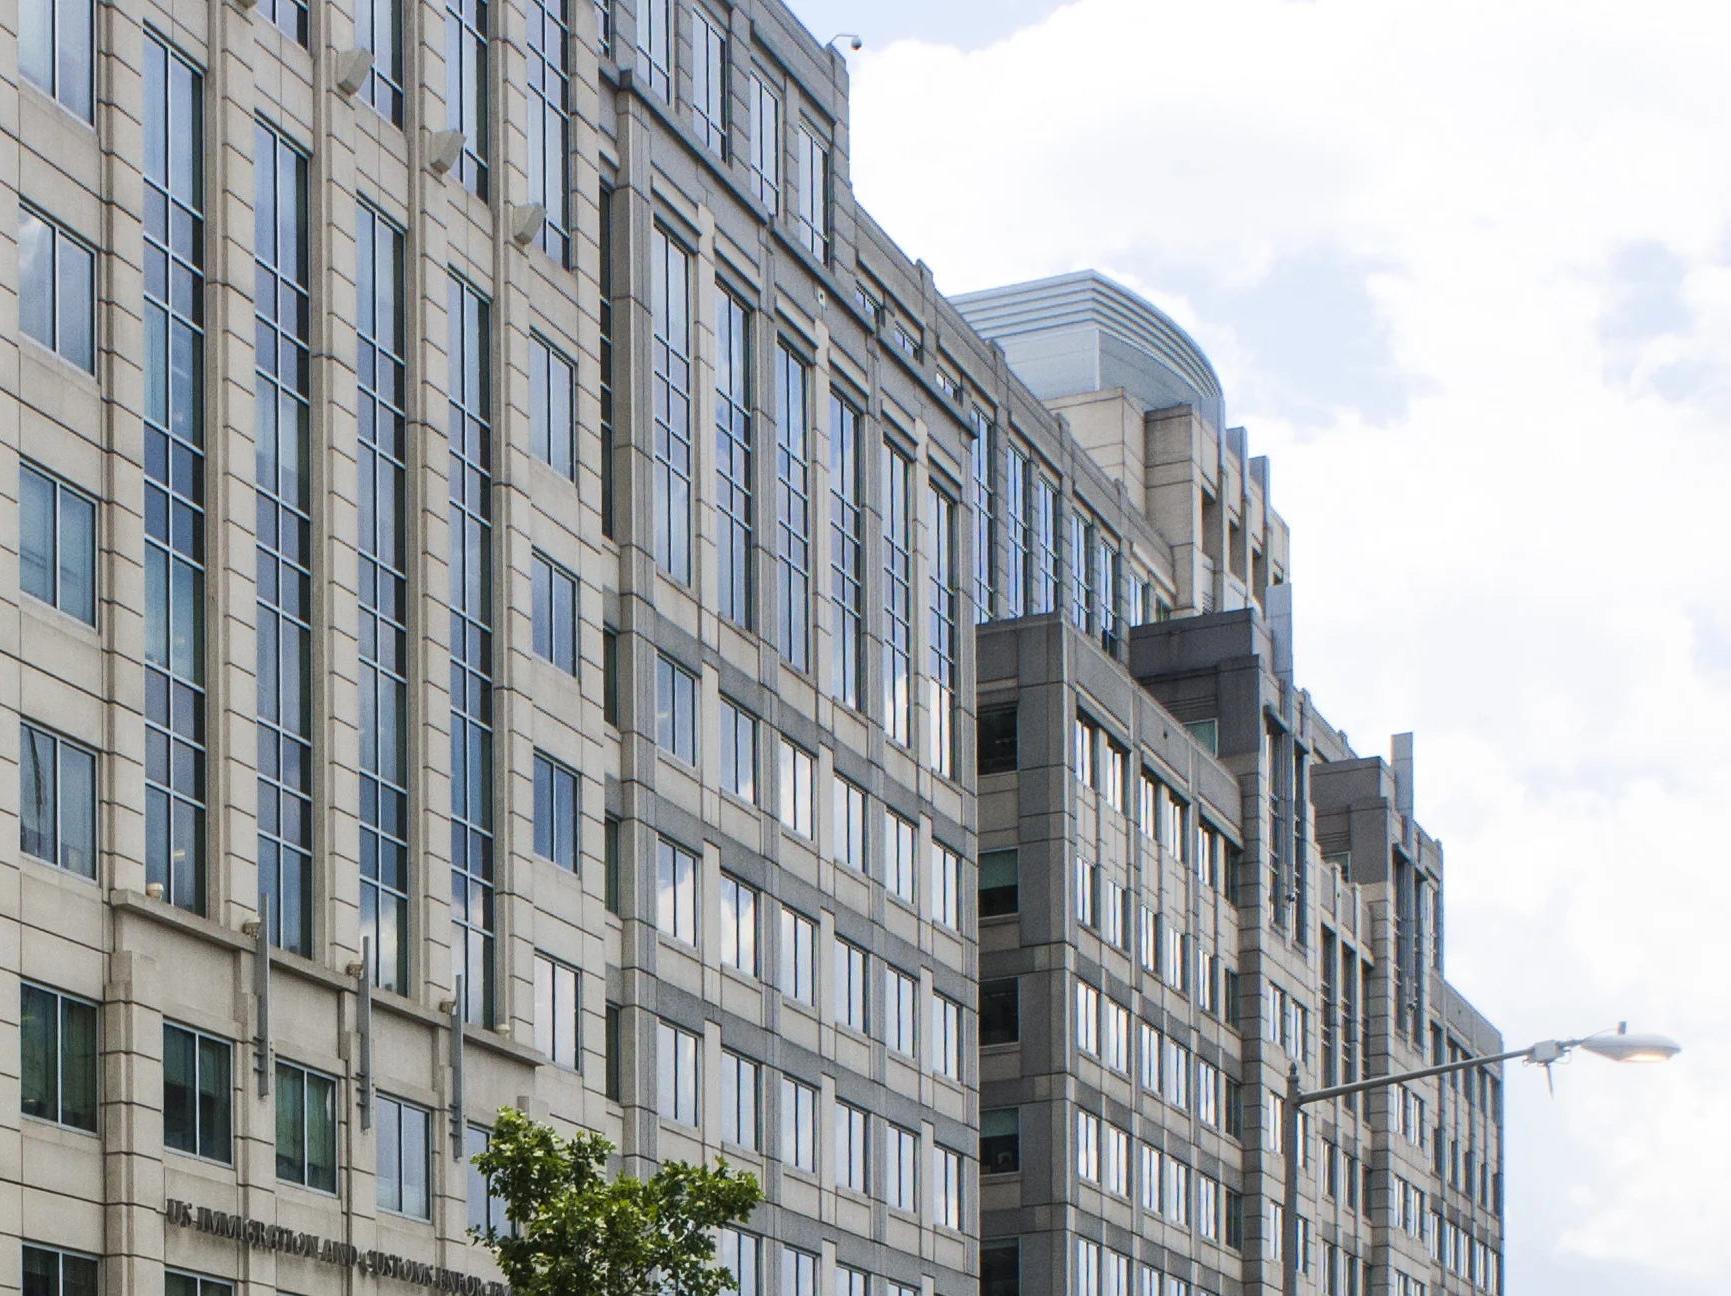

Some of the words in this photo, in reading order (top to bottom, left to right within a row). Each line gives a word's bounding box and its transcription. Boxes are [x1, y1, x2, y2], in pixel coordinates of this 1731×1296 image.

[196, 1206, 320, 1257] IMMIGRATION
[321, 1238, 358, 1267] AND
[358, 1249, 434, 1287] CUSTOMS
